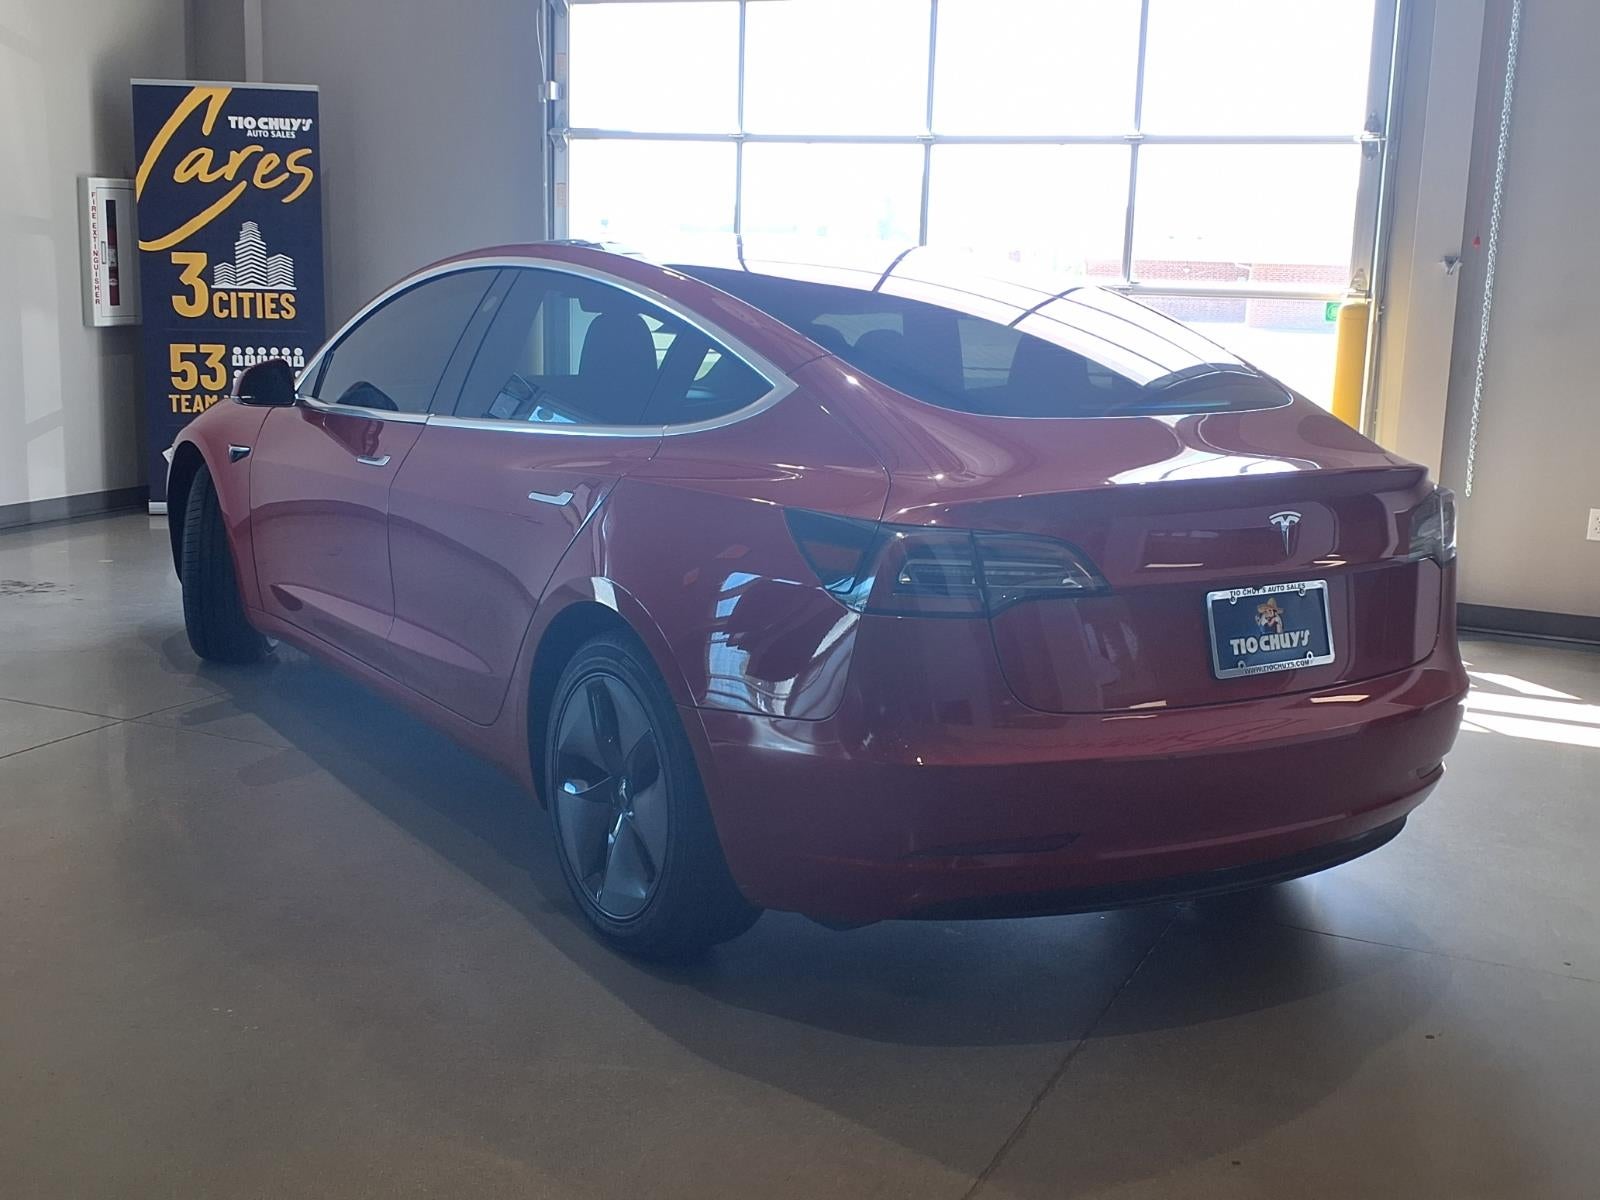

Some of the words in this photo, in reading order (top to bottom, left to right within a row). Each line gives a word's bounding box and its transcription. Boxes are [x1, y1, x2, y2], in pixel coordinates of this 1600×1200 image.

[228, 116, 257, 129] TIO
[257, 117, 313, 131] CHUY'S
[246, 129, 269, 137] AUTO
[270, 130, 296, 139] SALES
[136, 87, 313, 251] Cares
[92, 222, 100, 305] EXTINGUISHER
[170, 251, 209, 318] 3
[212, 291, 297, 320] CITIES
[169, 343, 227, 391] 53
[1229, 589, 1241, 598] TIO
[1267, 584, 1285, 593] AUTO
[1286, 582, 1307, 591] SALES
[1230, 637, 1258, 656] TIO
[1259, 629, 1311, 652] CHUY'S
